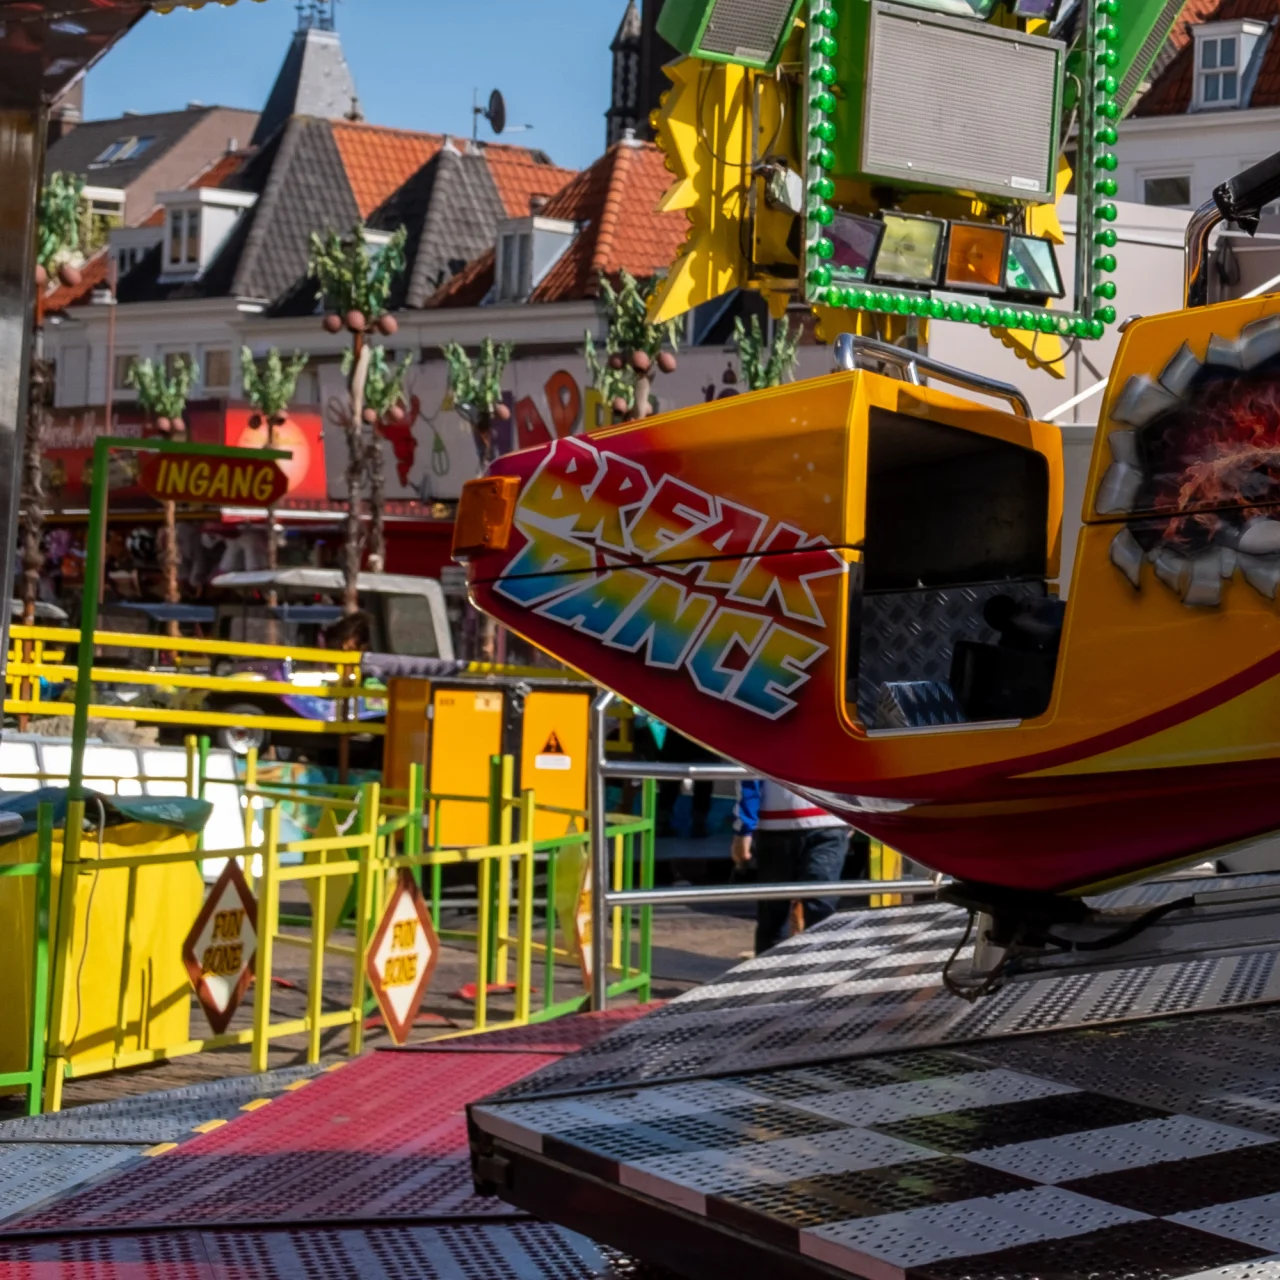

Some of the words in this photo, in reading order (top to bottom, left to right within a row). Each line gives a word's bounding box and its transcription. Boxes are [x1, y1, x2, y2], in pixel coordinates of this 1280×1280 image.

[155, 459, 275, 500] INGANG
[514, 436, 849, 627] BREAK
[492, 523, 829, 720] DANCE
[213, 909, 245, 939] FUN
[391, 920, 418, 949] FUN
